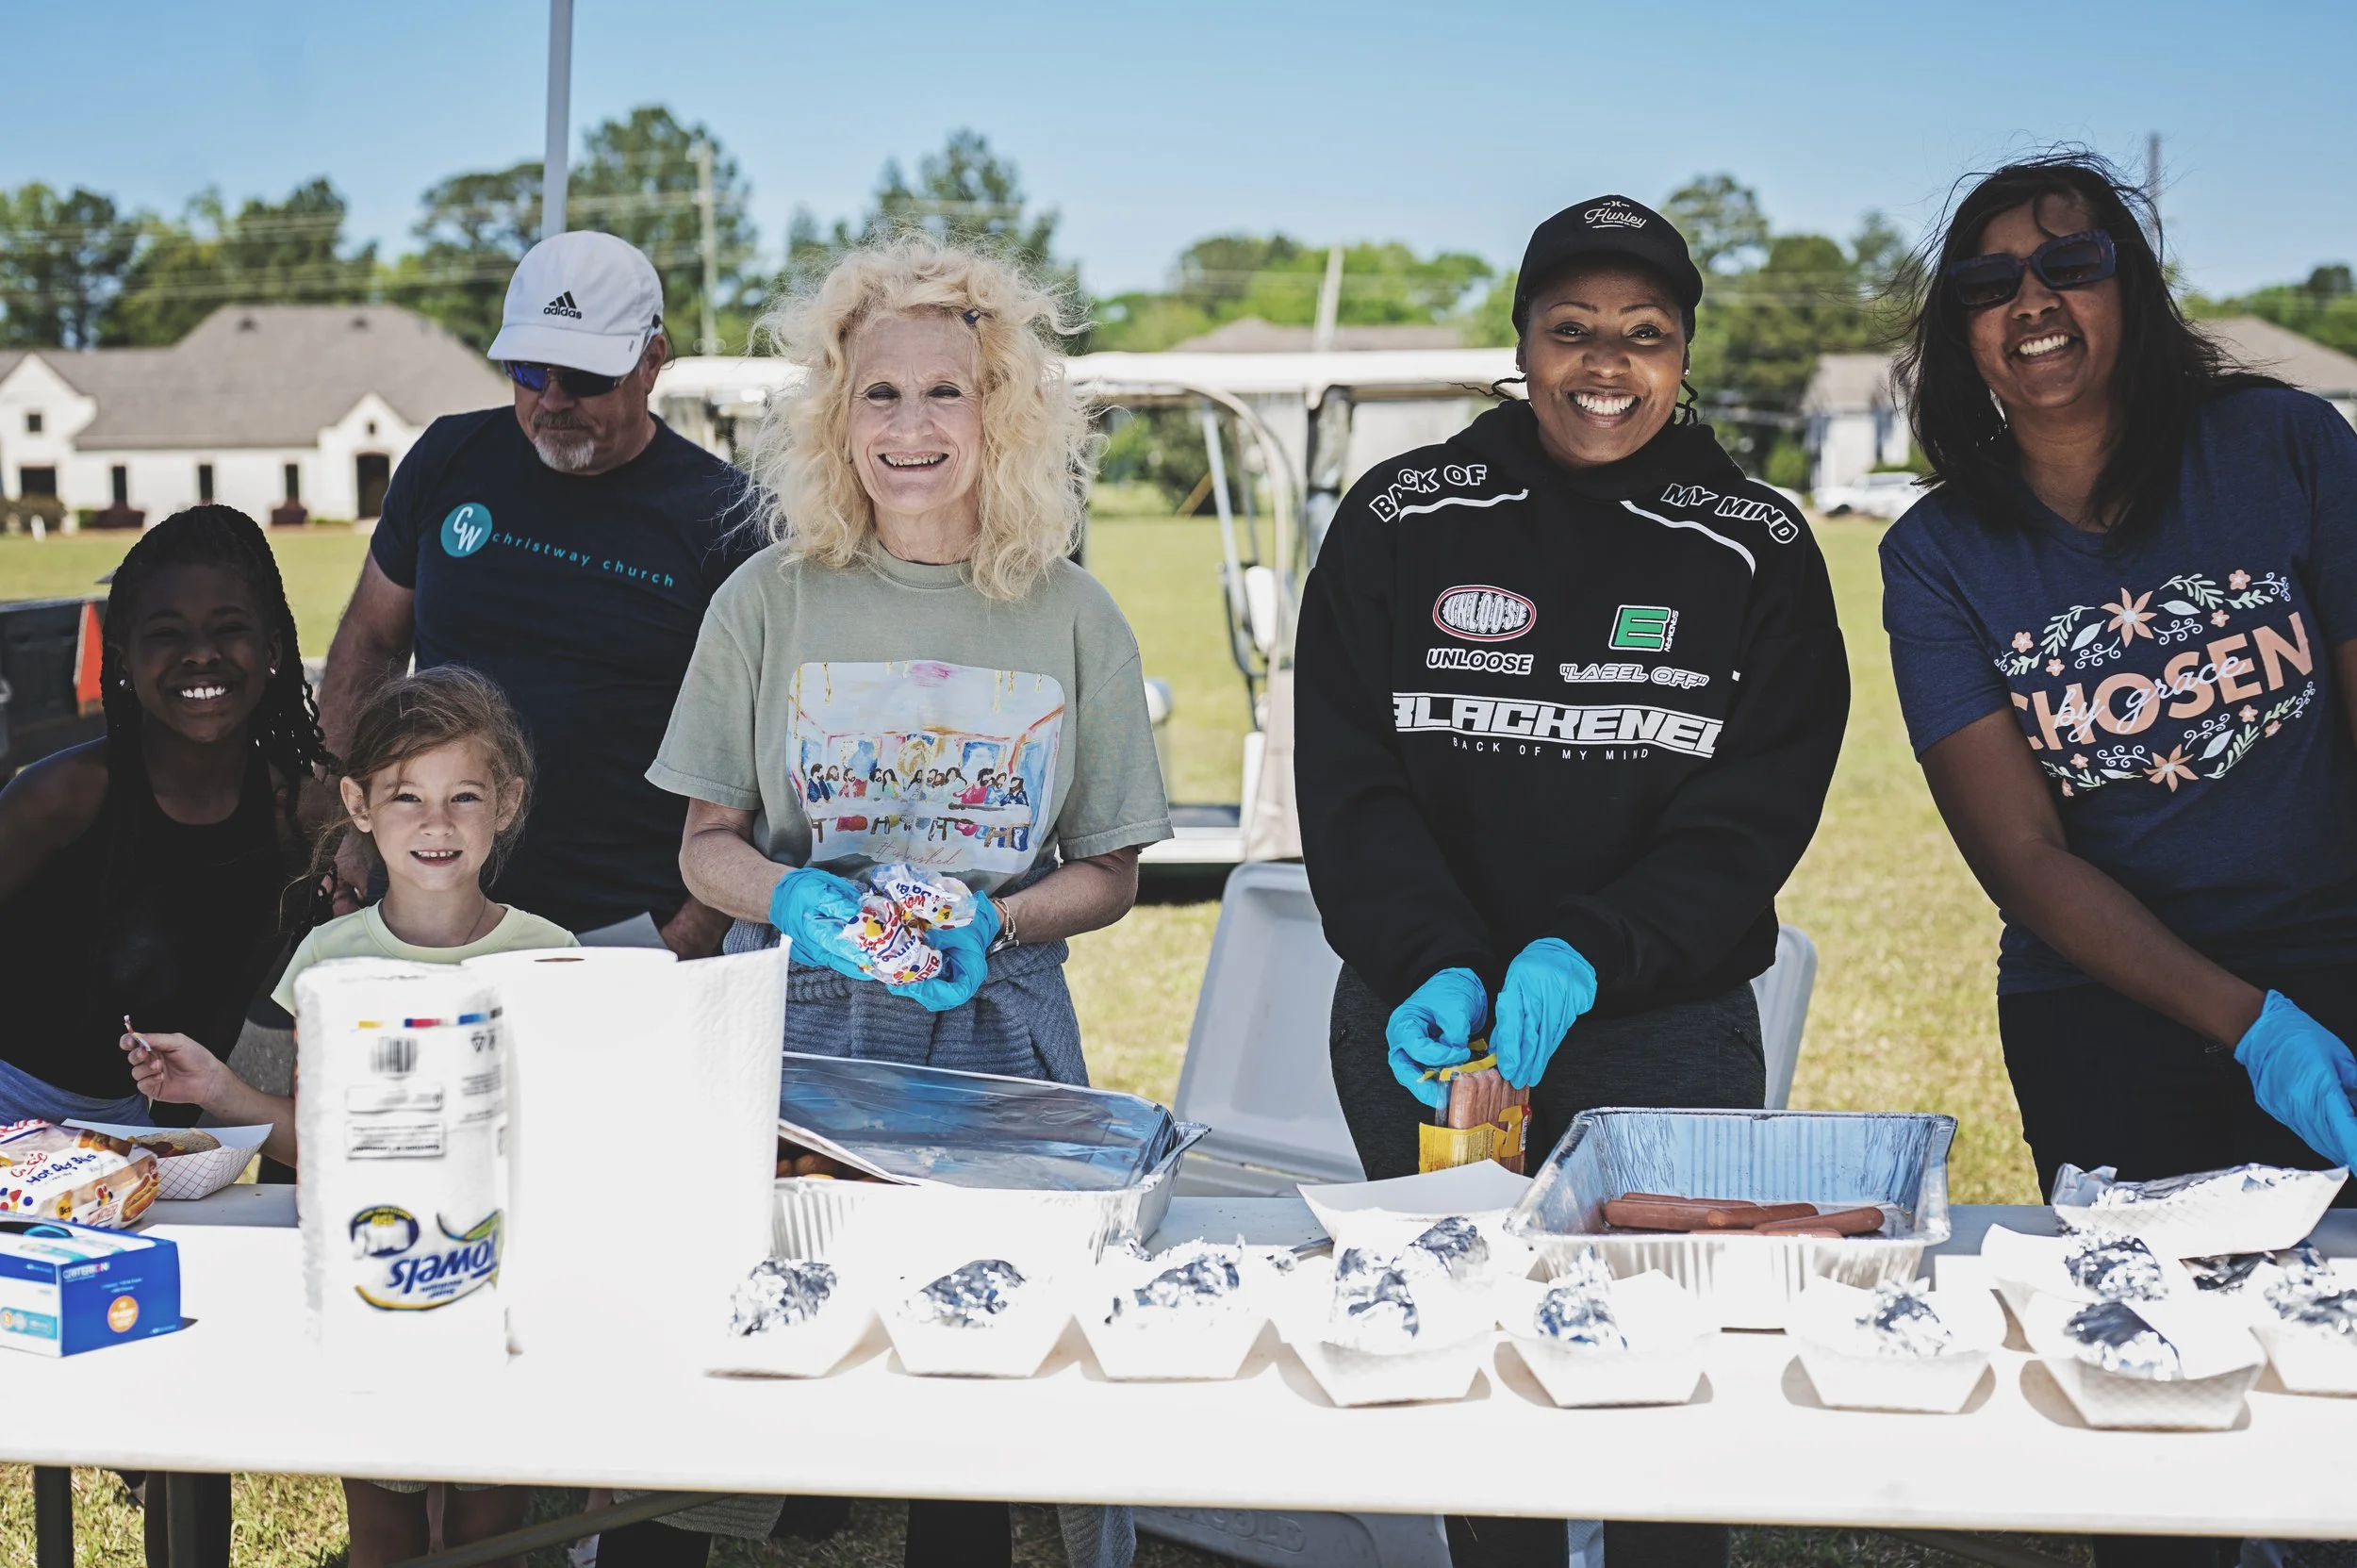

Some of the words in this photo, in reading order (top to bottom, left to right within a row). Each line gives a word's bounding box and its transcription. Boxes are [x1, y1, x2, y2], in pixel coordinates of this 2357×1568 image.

[1584, 207, 1647, 228] Hurley
[543, 305, 583, 320] adidas
[1443, 464, 1488, 487] OF
[1660, 483, 1719, 508] MY
[1714, 496, 1799, 544] MIND
[492, 532, 591, 567] christway
[602, 559, 674, 587] church
[1442, 591, 1528, 634] UNLOOSE
[1426, 648, 1534, 675] UNLOOSE
[2053, 687, 2106, 743] by
[2116, 655, 2247, 733] grace
[1453, 736, 1500, 752] BACK
[1519, 744, 1541, 756] OF
[1562, 749, 1588, 761] MY
[1606, 749, 1649, 760] MIND
[386, 1229, 498, 1296] Towels
